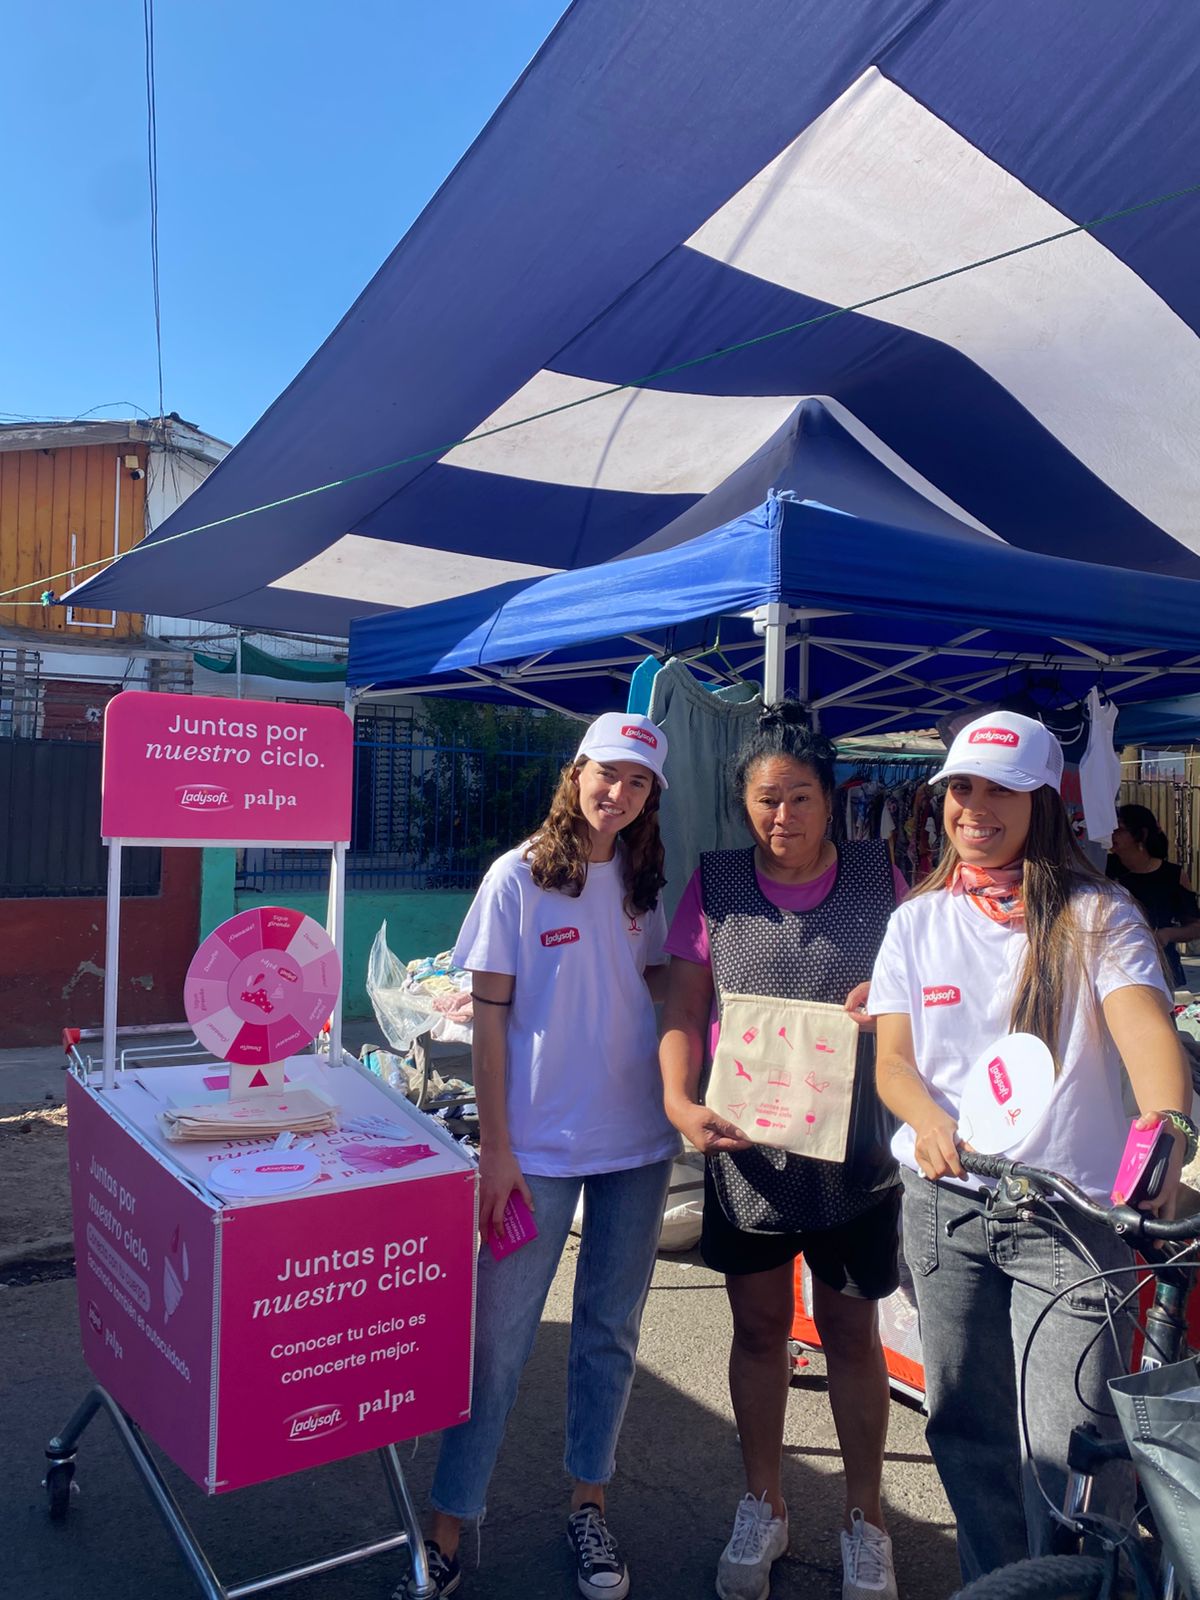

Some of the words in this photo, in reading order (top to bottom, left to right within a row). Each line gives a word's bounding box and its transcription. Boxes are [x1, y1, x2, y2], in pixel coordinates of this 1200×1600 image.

[168, 714, 258, 738] Juntas
[266, 725, 308, 745] por
[625, 727, 655, 744] Ladysoft
[972, 730, 1015, 743] Ladysoft
[145, 743, 251, 764] nuestro
[260, 746, 325, 768] ciclo.
[181, 789, 229, 805] Ladysoft
[244, 789, 297, 810] palpa
[545, 929, 576, 946] Ladysoft
[989, 1062, 1011, 1098] Ladysoft
[89, 1155, 118, 1198] Juntas
[120, 1185, 136, 1215] por
[88, 1192, 122, 1240] nuestro
[124, 1228, 151, 1272] ciclo.
[277, 1247, 375, 1282] Juntas
[384, 1235, 428, 1268] por
[252, 1278, 367, 1319] nuestro
[378, 1261, 447, 1291] ciclo.
[104, 1327, 124, 1361] palpa
[270, 1332, 343, 1359] Conocer
[347, 1327, 364, 1342] tu
[367, 1317, 405, 1337] ciclo
[408, 1312, 427, 1327] es
[281, 1353, 367, 1384] conocerte
[370, 1340, 420, 1362] mejor.
[289, 1408, 342, 1438] Ladysoft
[358, 1388, 416, 1422] palpa
